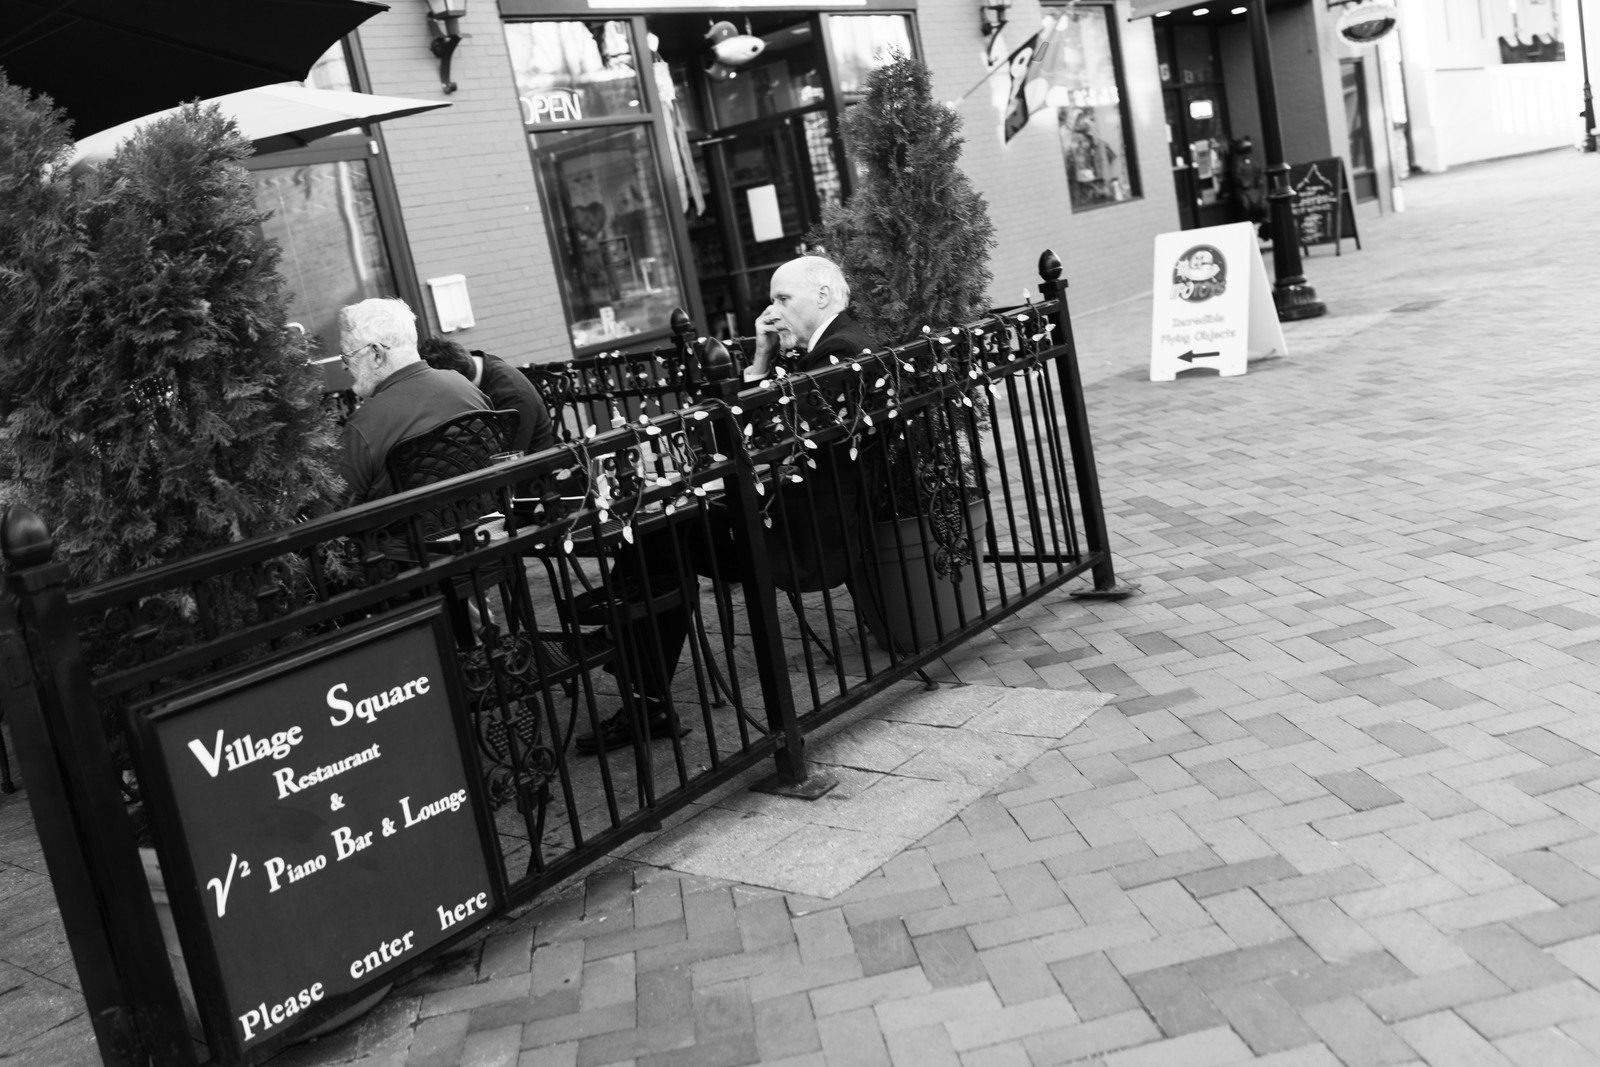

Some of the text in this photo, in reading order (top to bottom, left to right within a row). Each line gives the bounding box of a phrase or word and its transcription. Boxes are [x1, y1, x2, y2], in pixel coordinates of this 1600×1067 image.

[1160, 328, 1236, 346] Flying Objects
[187, 676, 431, 779] Village Square
[272, 742, 382, 800] Restaurant
[329, 792, 346, 812] &
[264, 852, 327, 893] Piano
[330, 825, 374, 862] Bar
[381, 816, 398, 838] &
[398, 787, 467, 829] Lounge
[238, 891, 488, 1042] Please enter here
